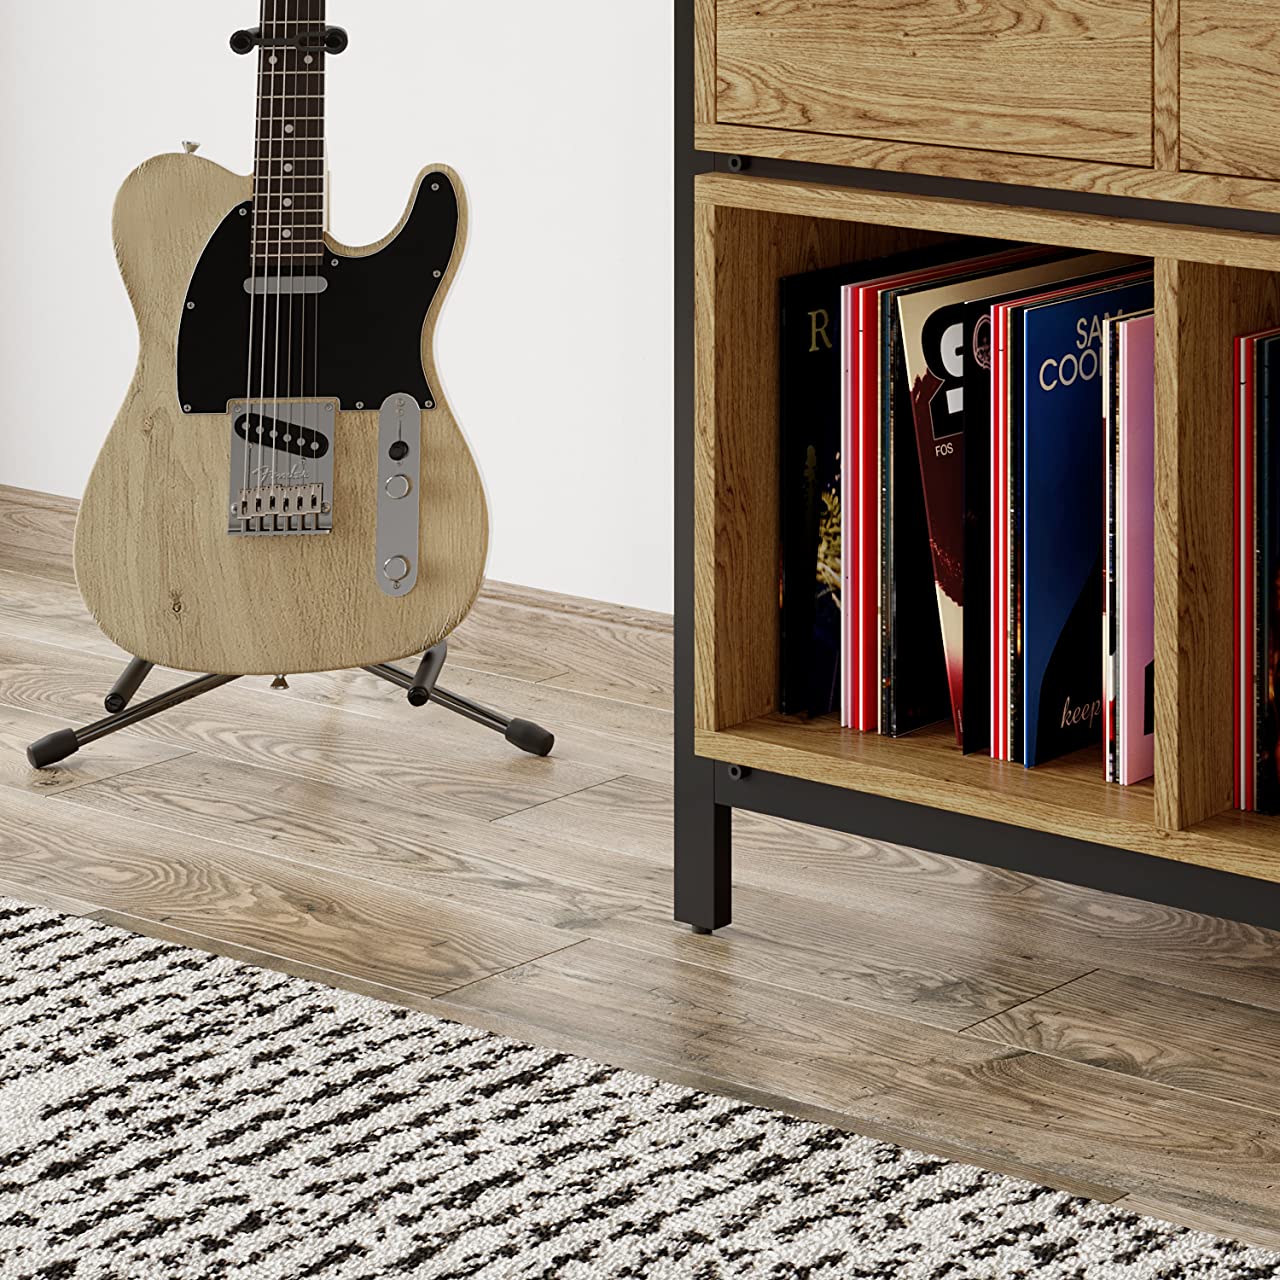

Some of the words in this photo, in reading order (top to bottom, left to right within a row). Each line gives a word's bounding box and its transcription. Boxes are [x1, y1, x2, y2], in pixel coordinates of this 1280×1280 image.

[1076, 309, 1123, 349] SA
[1039, 349, 1103, 391] COO
[935, 442, 954, 457] FOS
[1060, 695, 1101, 729] keep
